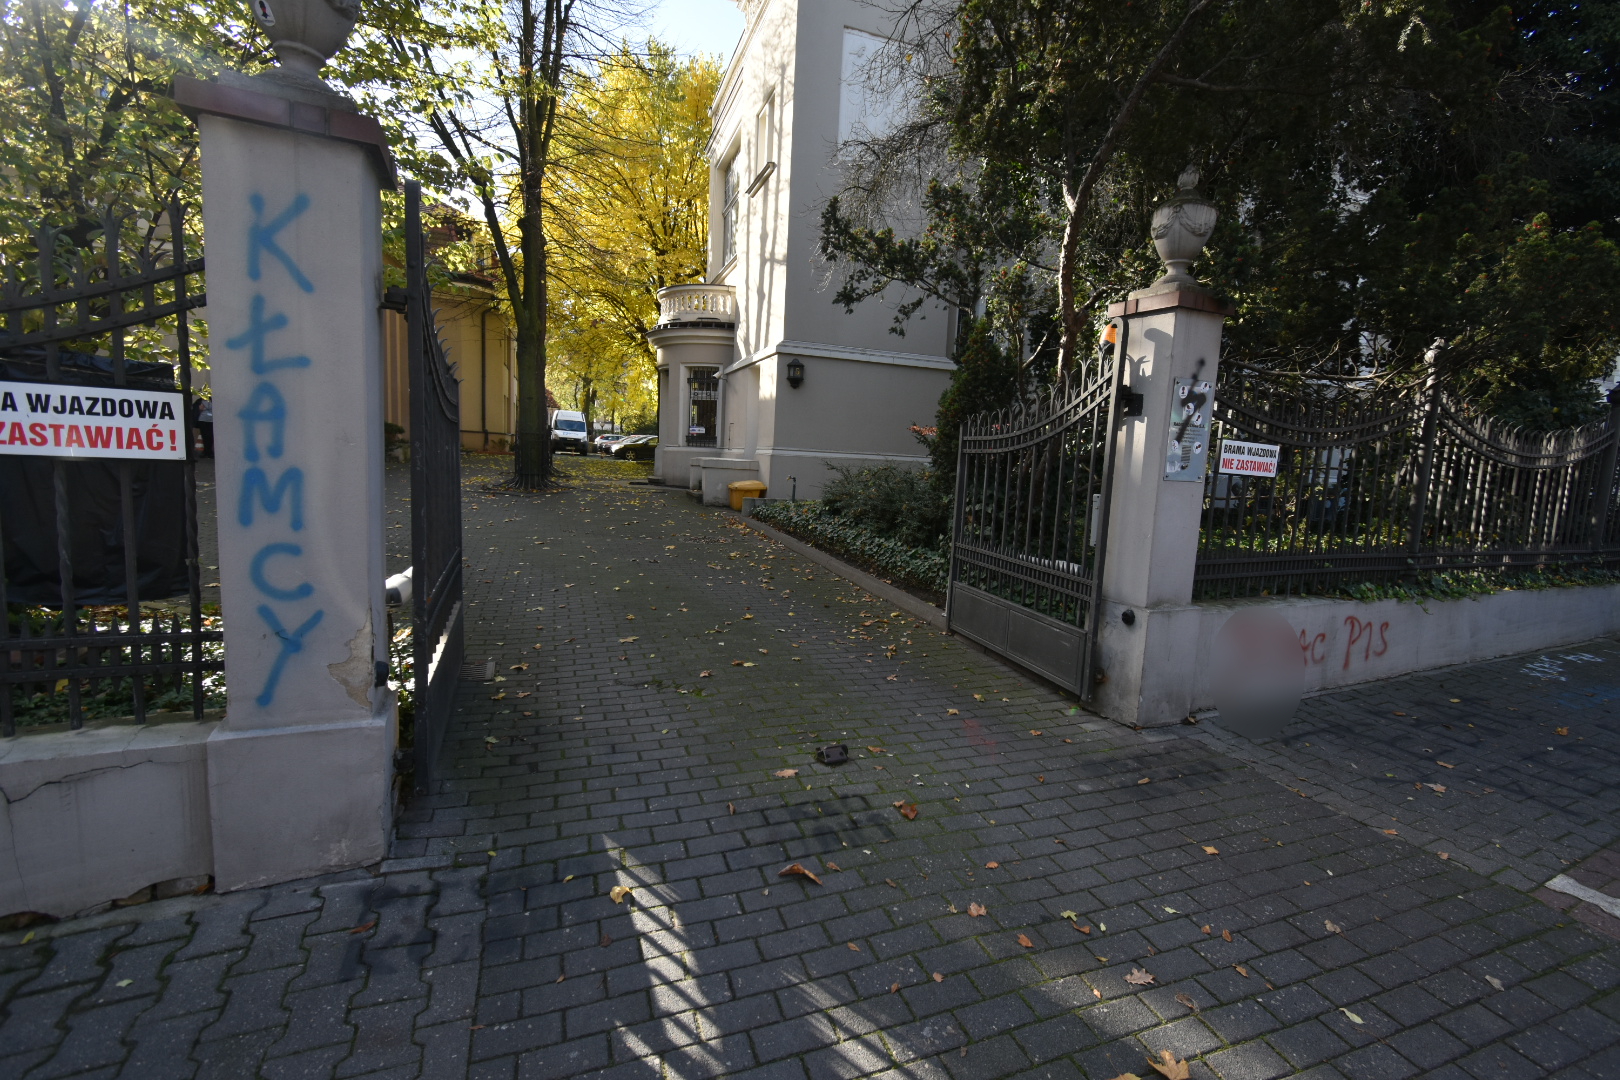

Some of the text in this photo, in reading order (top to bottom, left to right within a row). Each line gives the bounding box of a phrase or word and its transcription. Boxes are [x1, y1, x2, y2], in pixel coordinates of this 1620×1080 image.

[26, 392, 175, 420] WJAZDOWA
[226, 193, 324, 706] KŁAMCY
[1223, 444, 1277, 459] BRAMA WJAZDOWA
[1221, 458, 1235, 470] NIE
